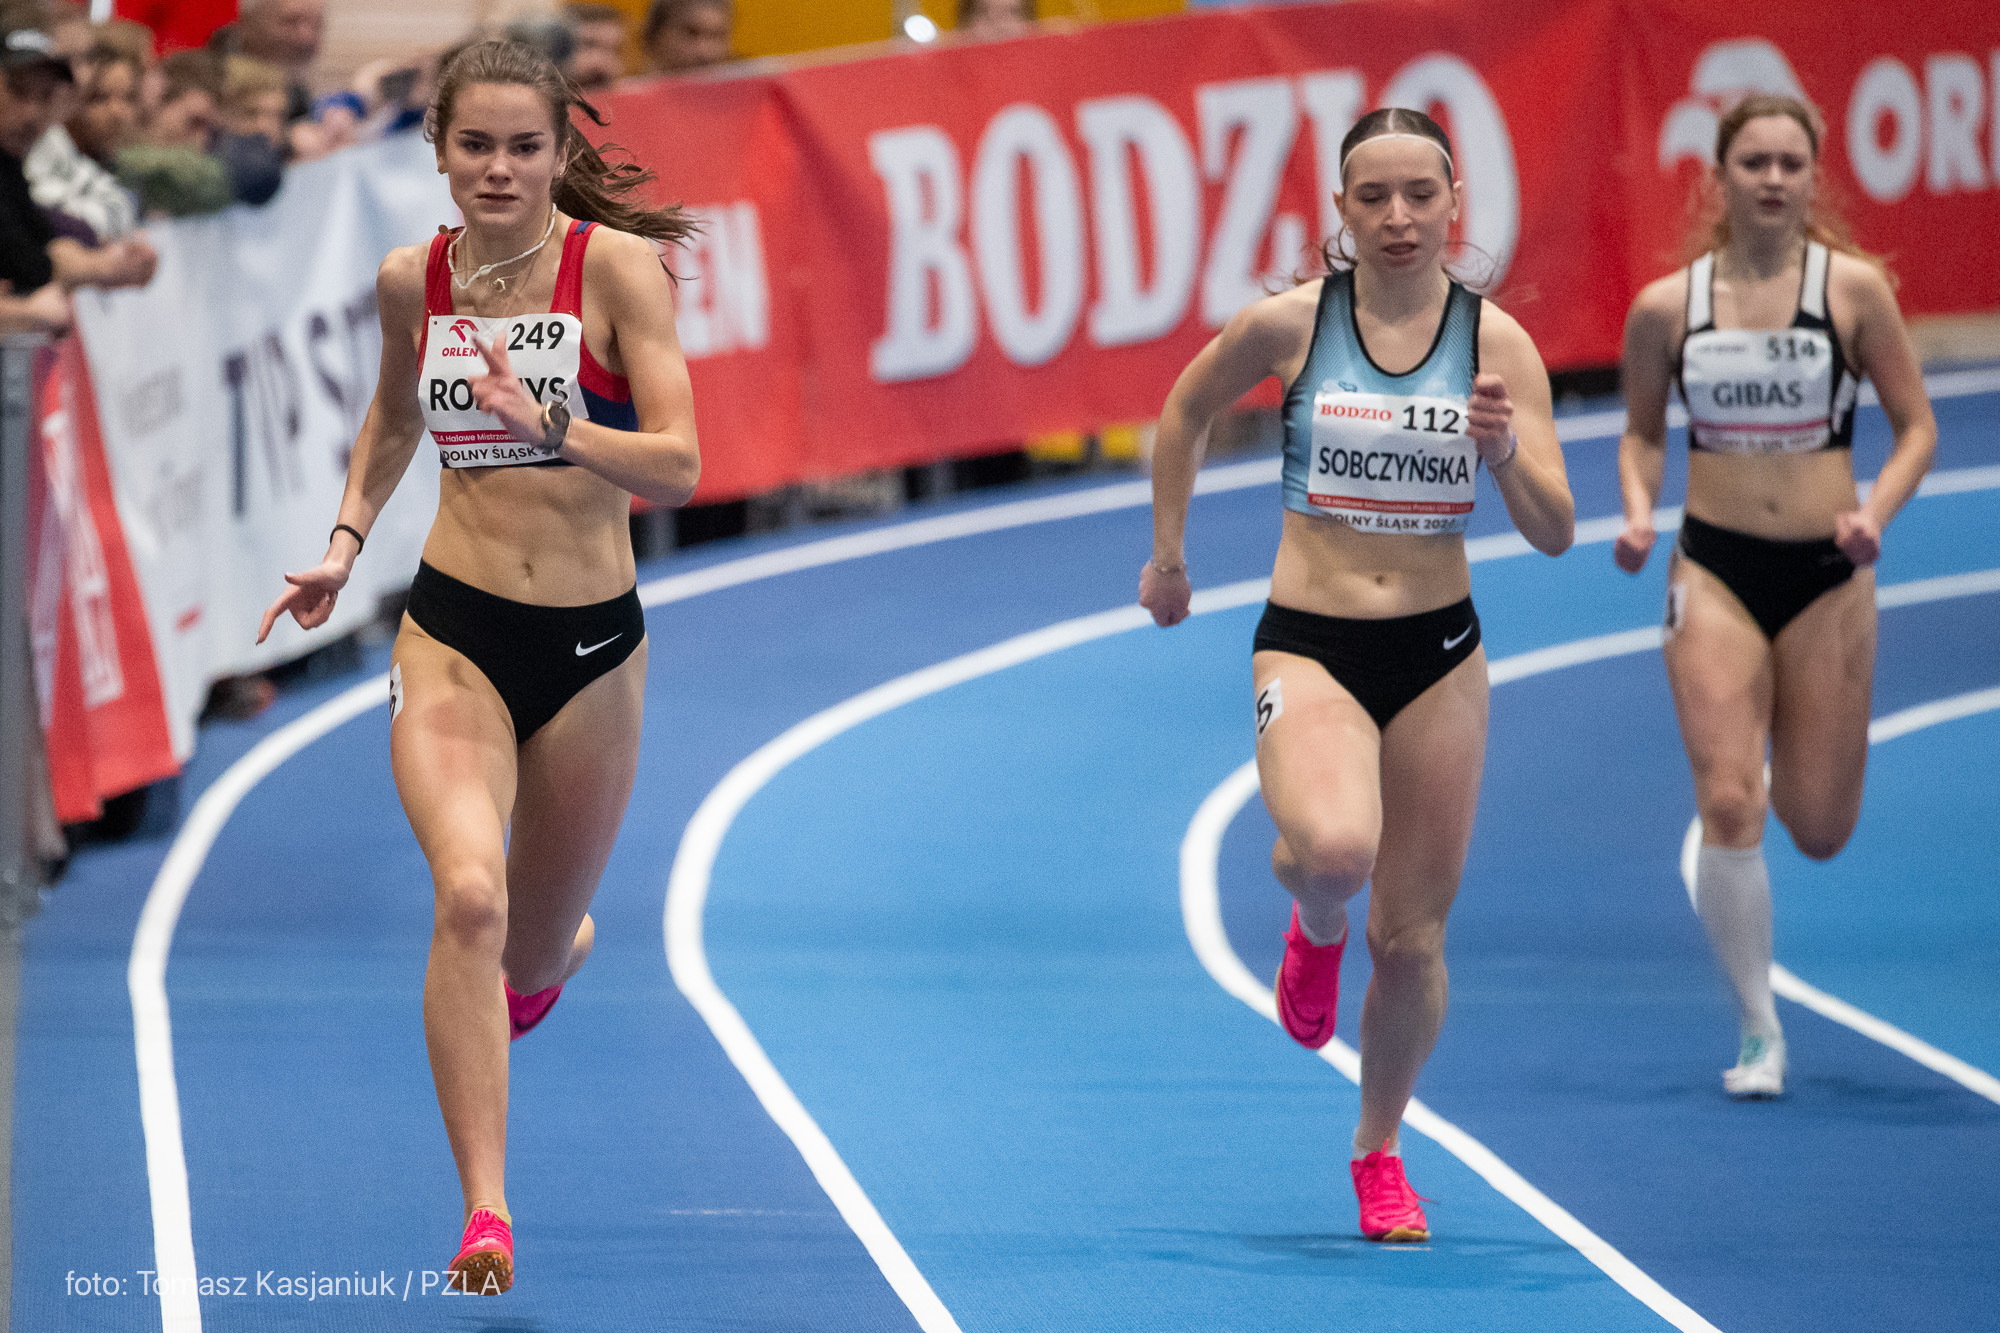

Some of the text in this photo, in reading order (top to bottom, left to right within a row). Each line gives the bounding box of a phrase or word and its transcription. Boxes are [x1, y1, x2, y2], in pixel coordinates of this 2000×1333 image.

[1844, 48, 2000, 205] OR
[867, 52, 1521, 383] BODZIO
[508, 321, 565, 351] 249
[1767, 336, 1816, 361] 514
[441, 347, 478, 358] ORLEN
[429, 377, 569, 411] ROYS
[1712, 381, 1803, 408] GIBAS
[1320, 403, 1392, 421] BODZIO
[446, 434, 476, 443] Halowe
[477, 432, 518, 441] Mistrzostw
[492, 445, 537, 460] ŚLĄSK
[1318, 447, 1470, 485] SOBCZYŃSKA
[1376, 514, 1420, 531] ŚLĄSK
